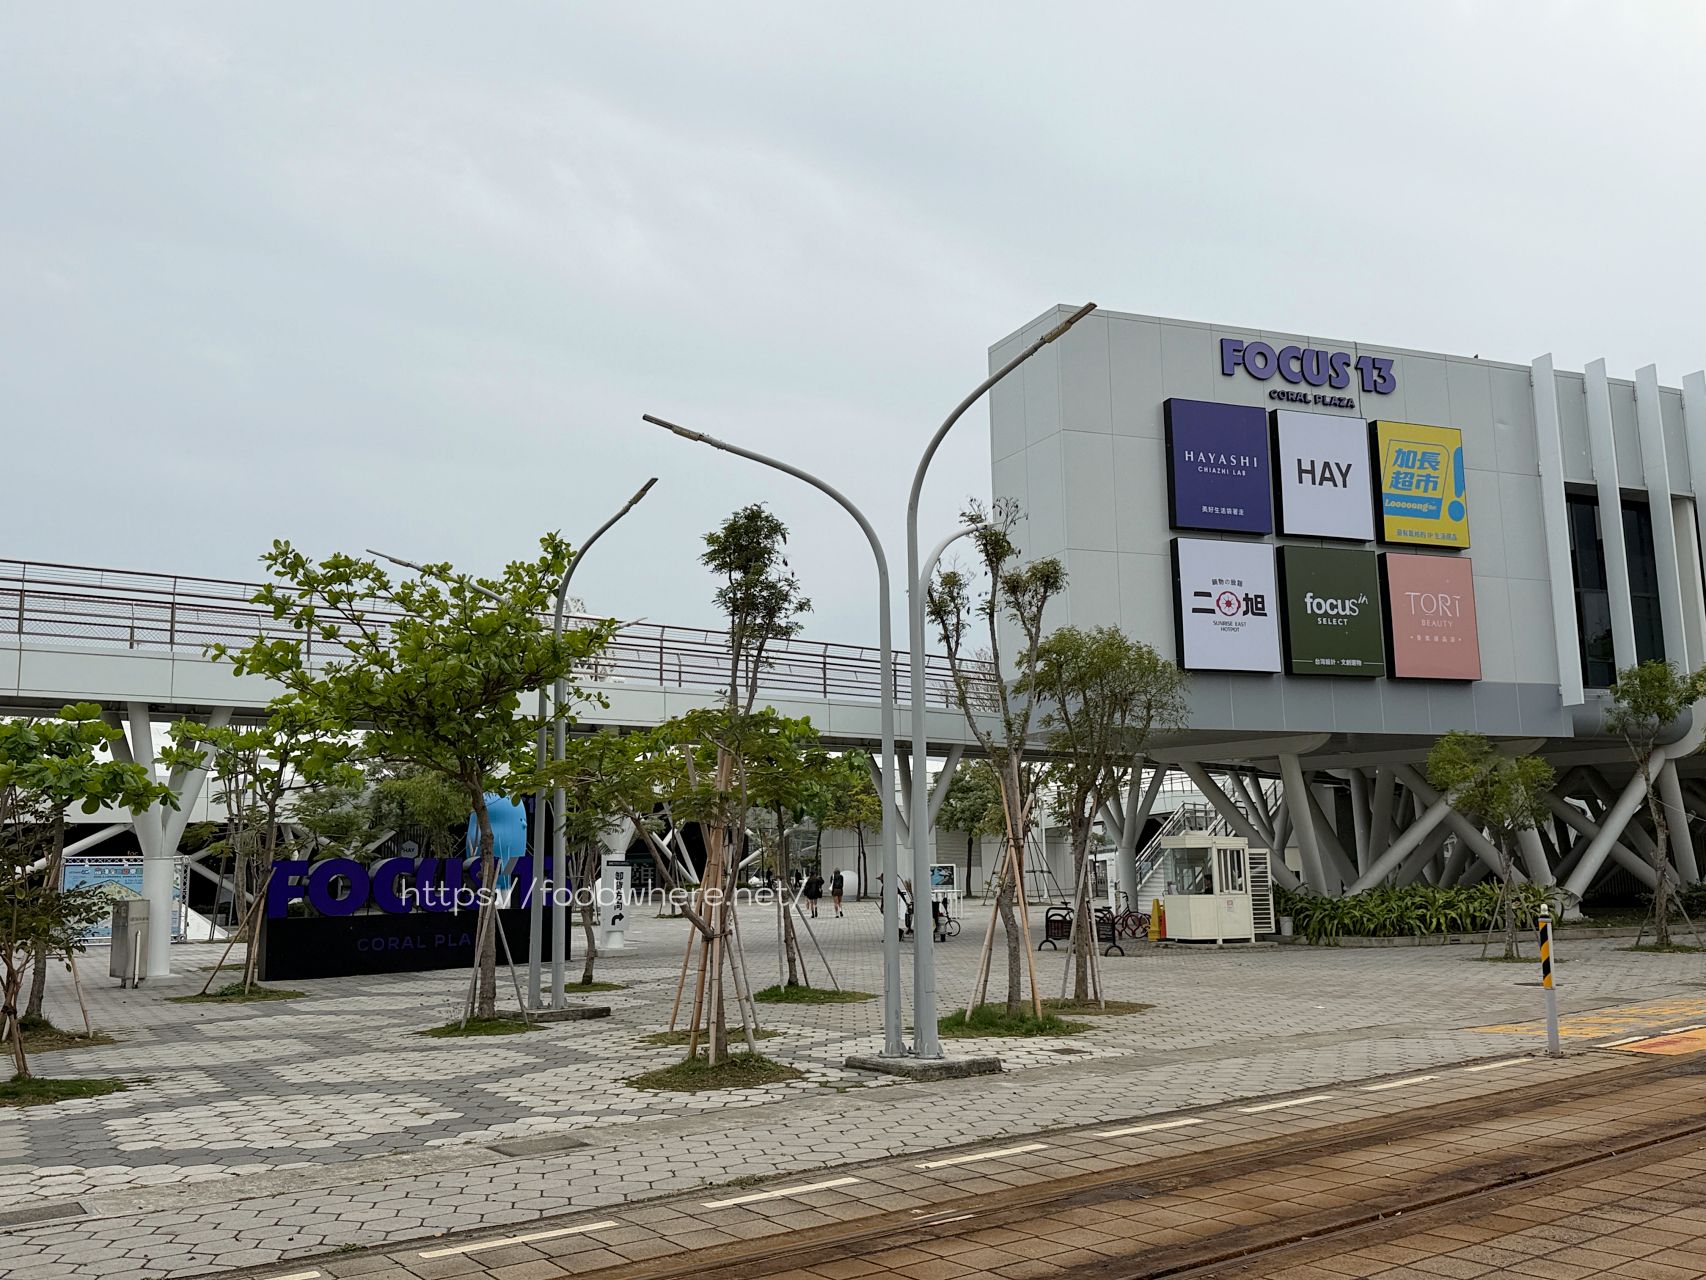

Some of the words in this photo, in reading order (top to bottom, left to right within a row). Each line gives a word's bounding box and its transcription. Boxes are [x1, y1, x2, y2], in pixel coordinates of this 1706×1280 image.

[1220, 338, 1351, 389] FOCUS
[1356, 355, 1396, 394] 13
[1269, 389, 1311, 404] CORAL
[1314, 393, 1355, 409] PLAZA
[1185, 450, 1258, 468] HAYASHI
[1392, 447, 1441, 471] 加長
[1197, 466, 1229, 475] CHIAZHI
[1296, 458, 1353, 489] HAY
[1389, 470, 1440, 493] 超市
[1304, 592, 1359, 616] focus
[1317, 617, 1348, 625] SELECT
[1421, 619, 1453, 628] BEAUTY
[613, 871, 624, 911] 卸貨方向
[357, 934, 426, 951] CORAL
[435, 932, 472, 949] PLA
